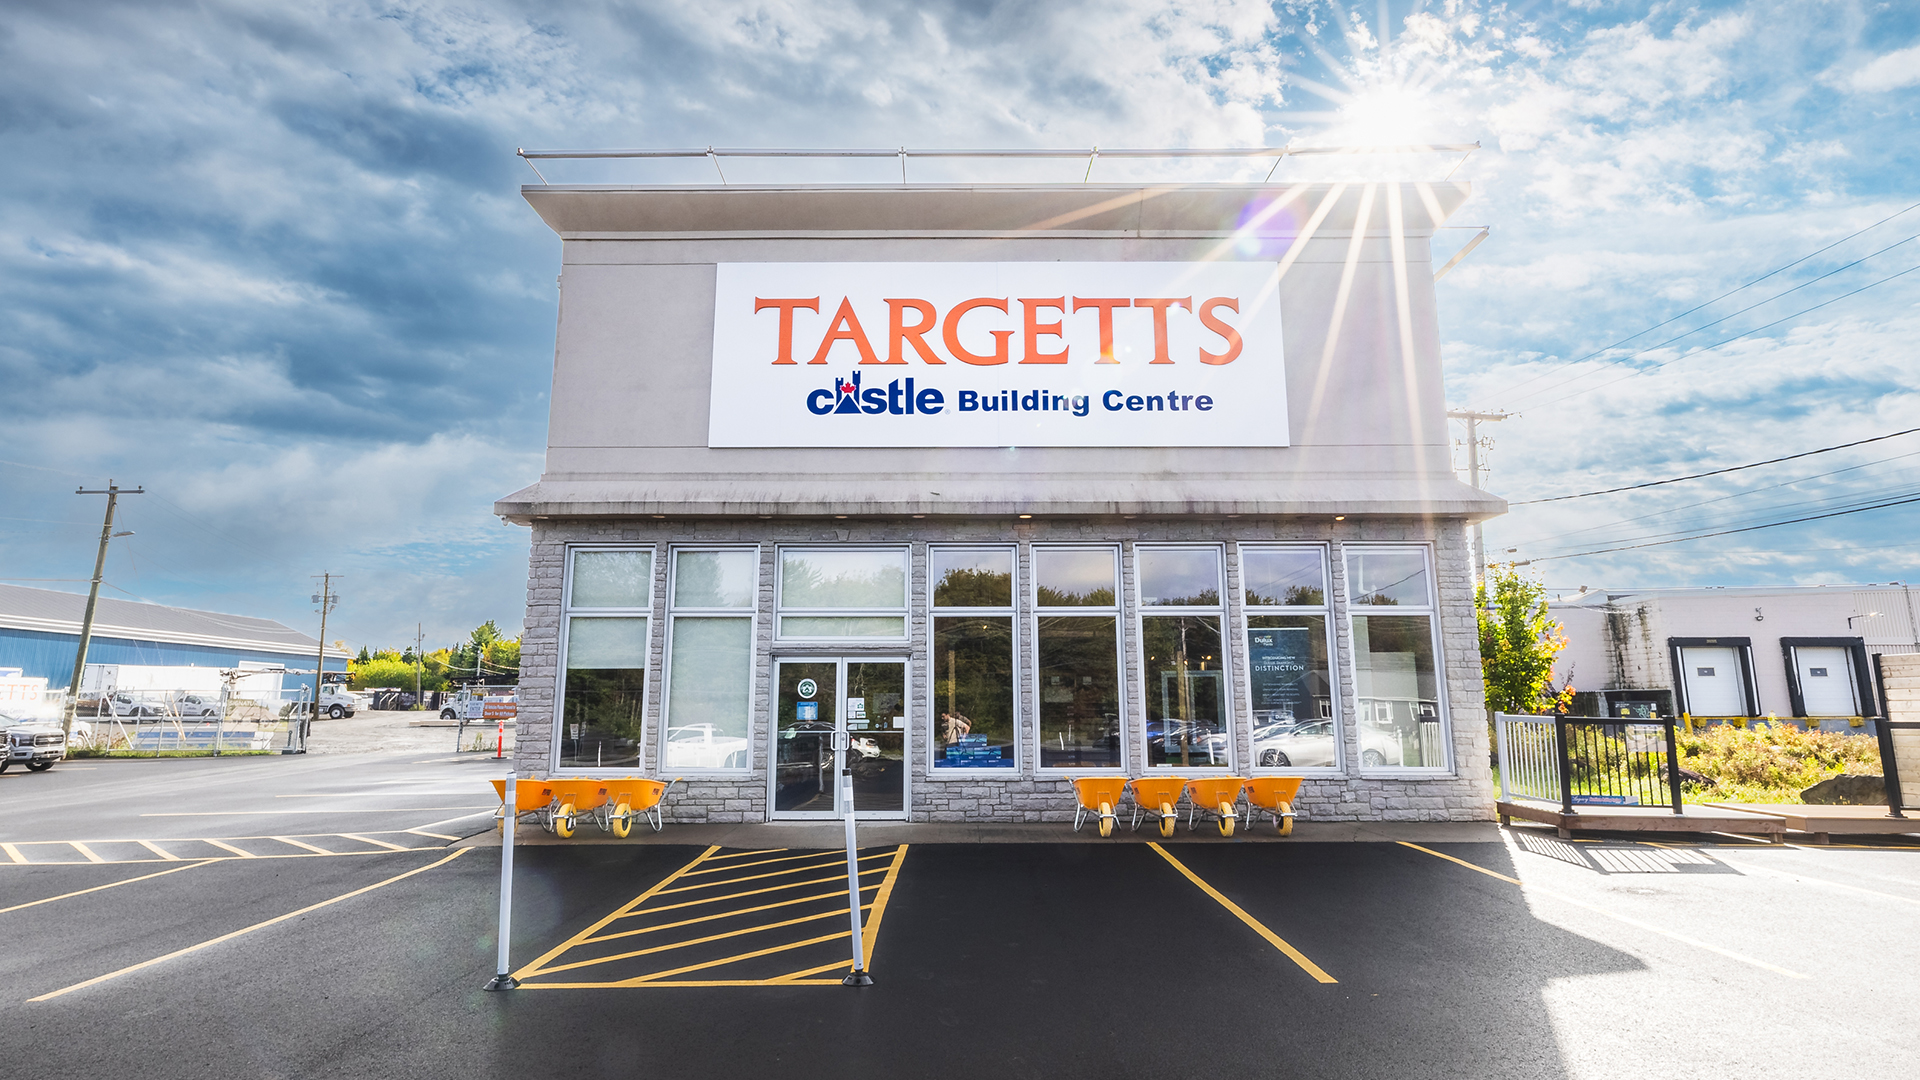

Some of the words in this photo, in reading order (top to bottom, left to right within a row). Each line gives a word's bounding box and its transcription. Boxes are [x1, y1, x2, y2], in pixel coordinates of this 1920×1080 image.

[755, 297, 1243, 365] TARGETTS
[959, 389, 1090, 416] Building
[1103, 389, 1213, 411] Centre
